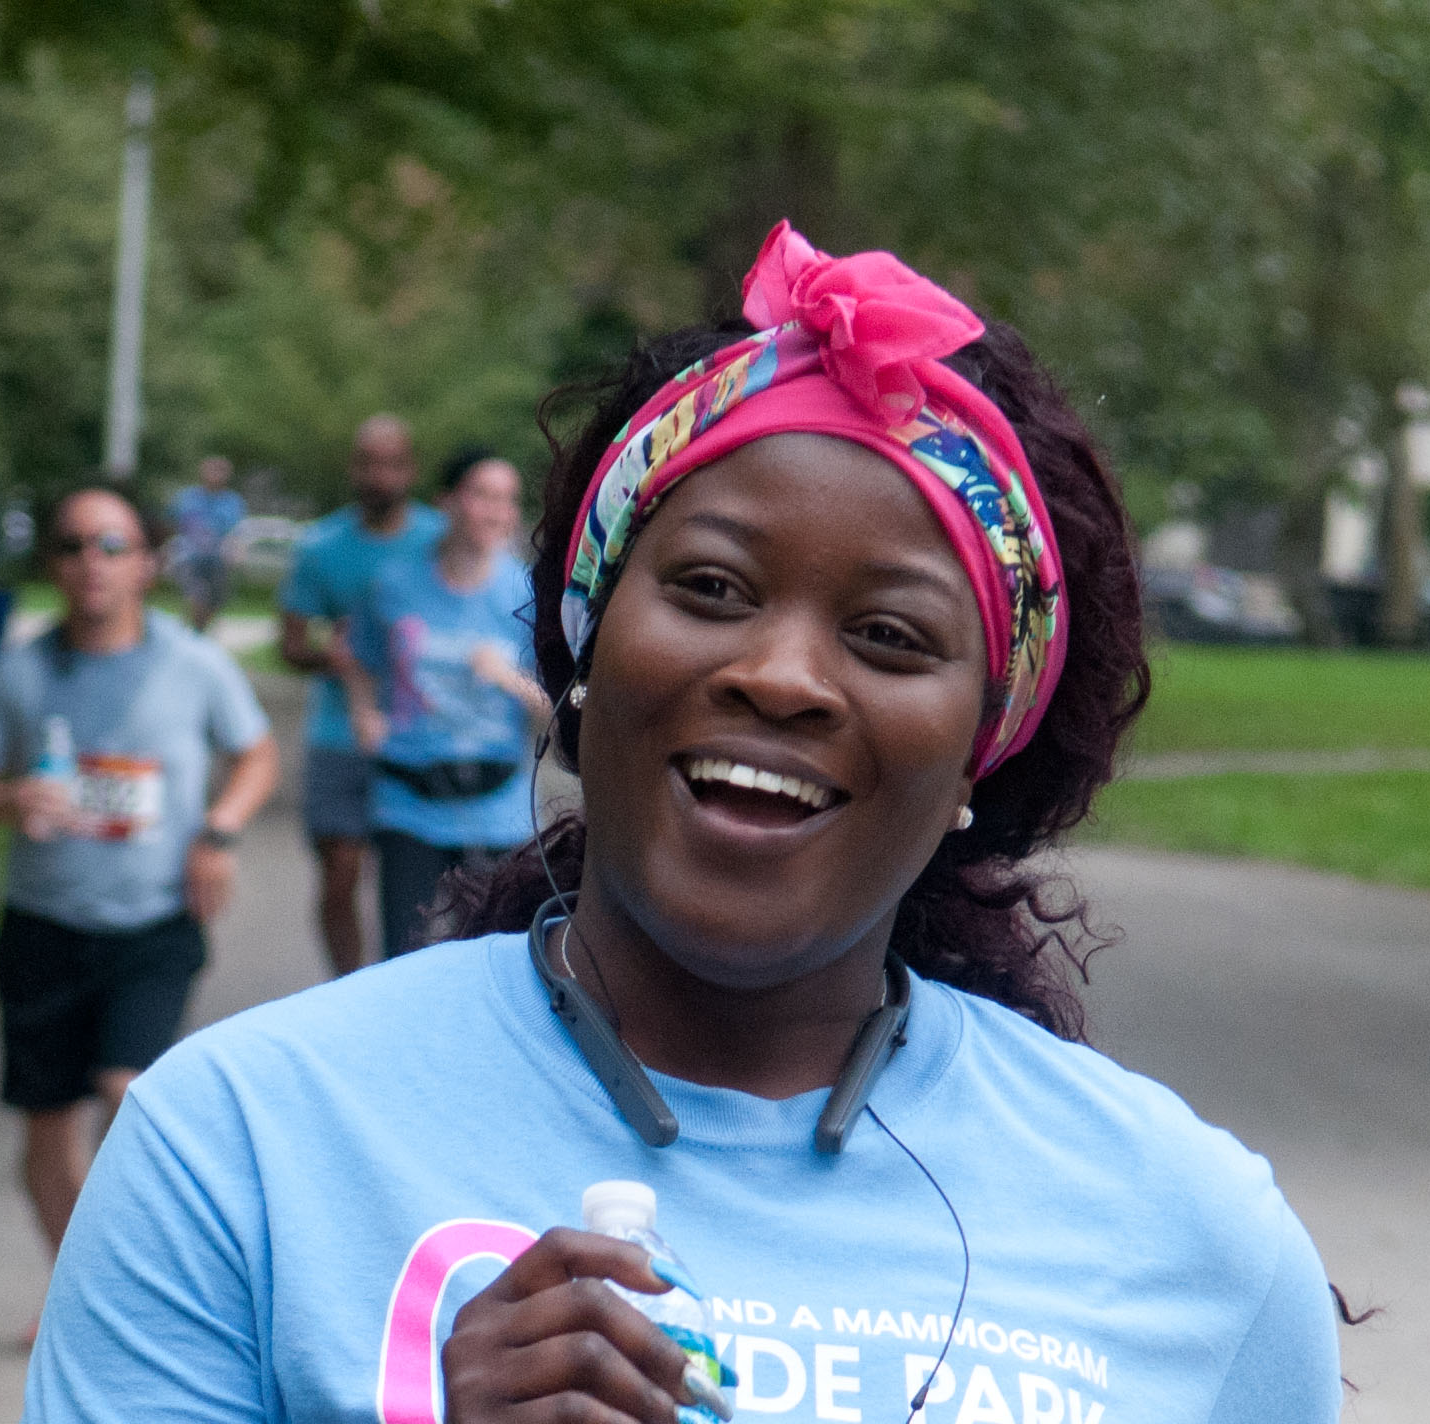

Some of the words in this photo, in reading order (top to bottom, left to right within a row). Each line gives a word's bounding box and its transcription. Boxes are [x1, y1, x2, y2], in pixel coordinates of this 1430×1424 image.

[709, 1297, 777, 1327] ND
[789, 1304, 823, 1332] A
[832, 1306, 1109, 1390] MAMMOGRAM
